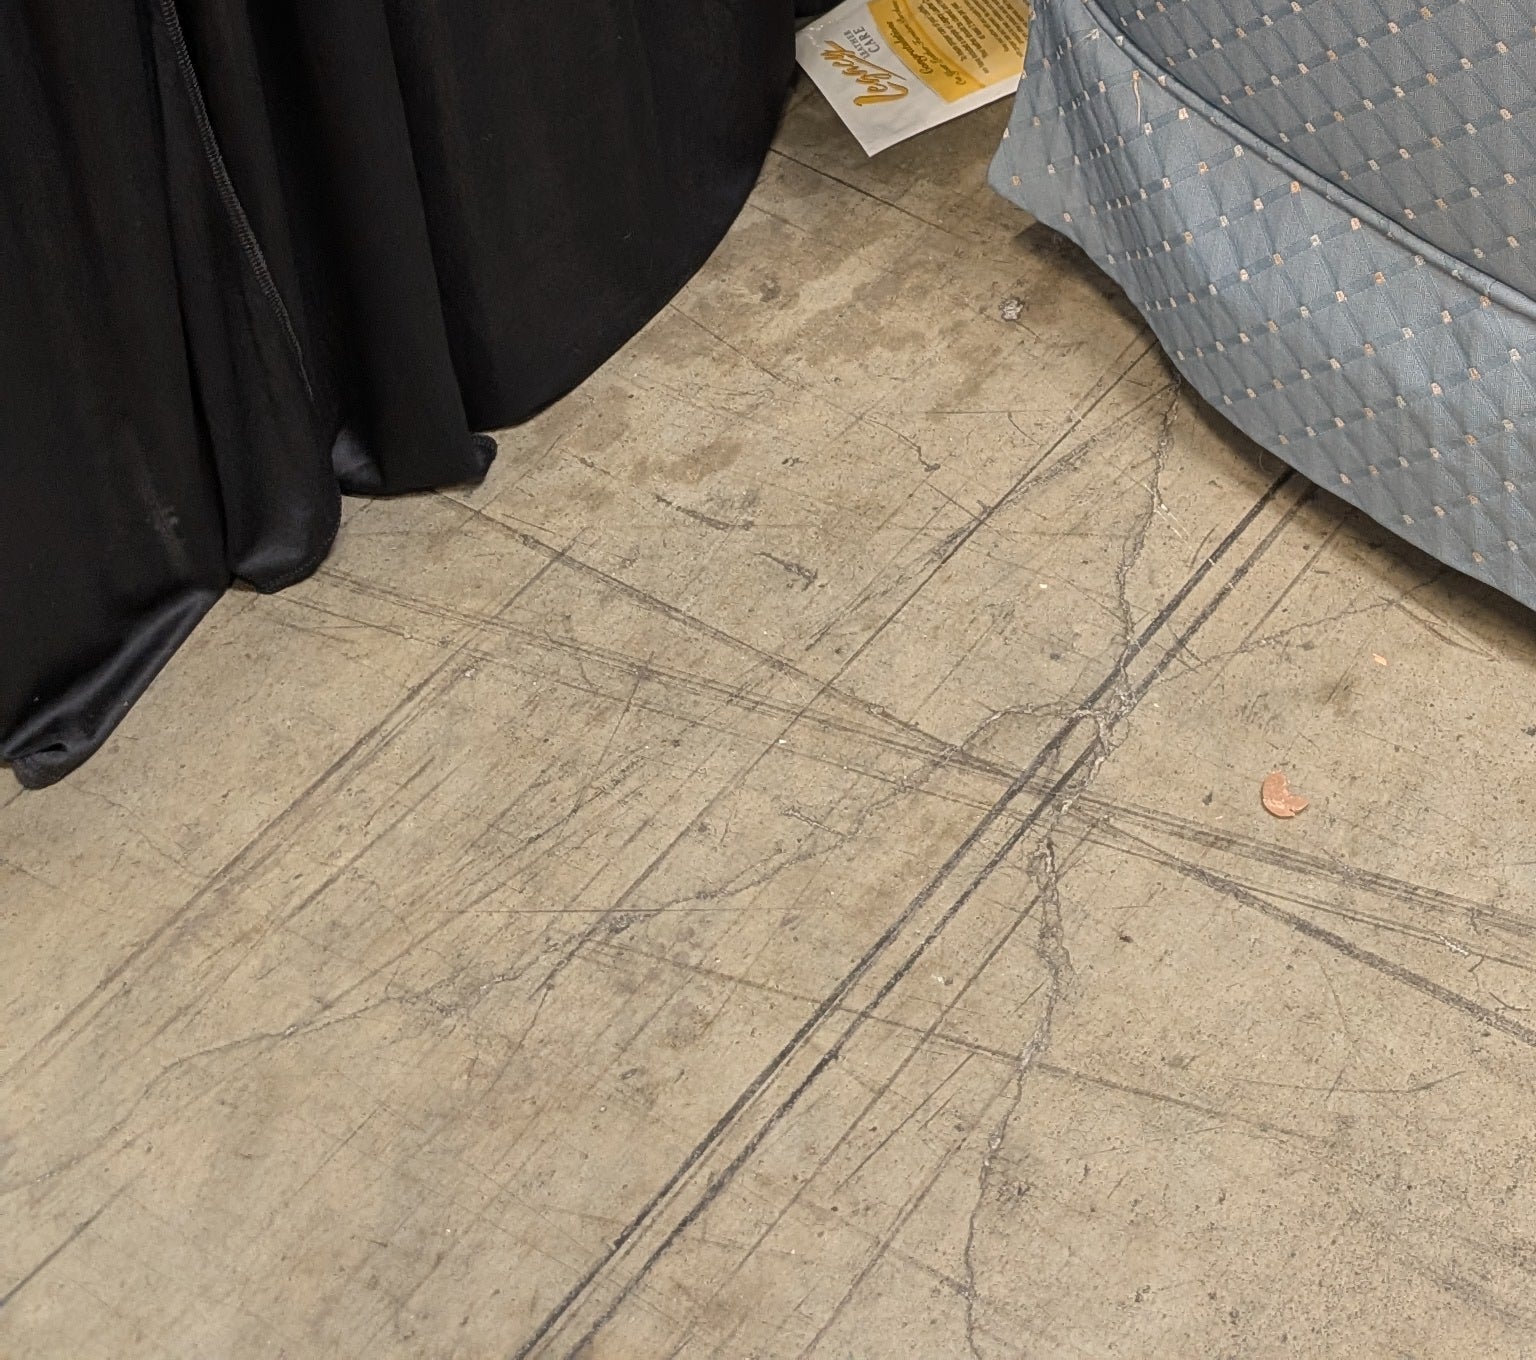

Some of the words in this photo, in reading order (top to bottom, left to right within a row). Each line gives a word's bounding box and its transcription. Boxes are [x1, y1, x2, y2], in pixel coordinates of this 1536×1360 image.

[843, 29, 870, 60] LEATHER
[852, 26, 881, 54] CARE
[886, 20, 934, 75] Congratulations
[820, 40, 909, 107] Legacy
